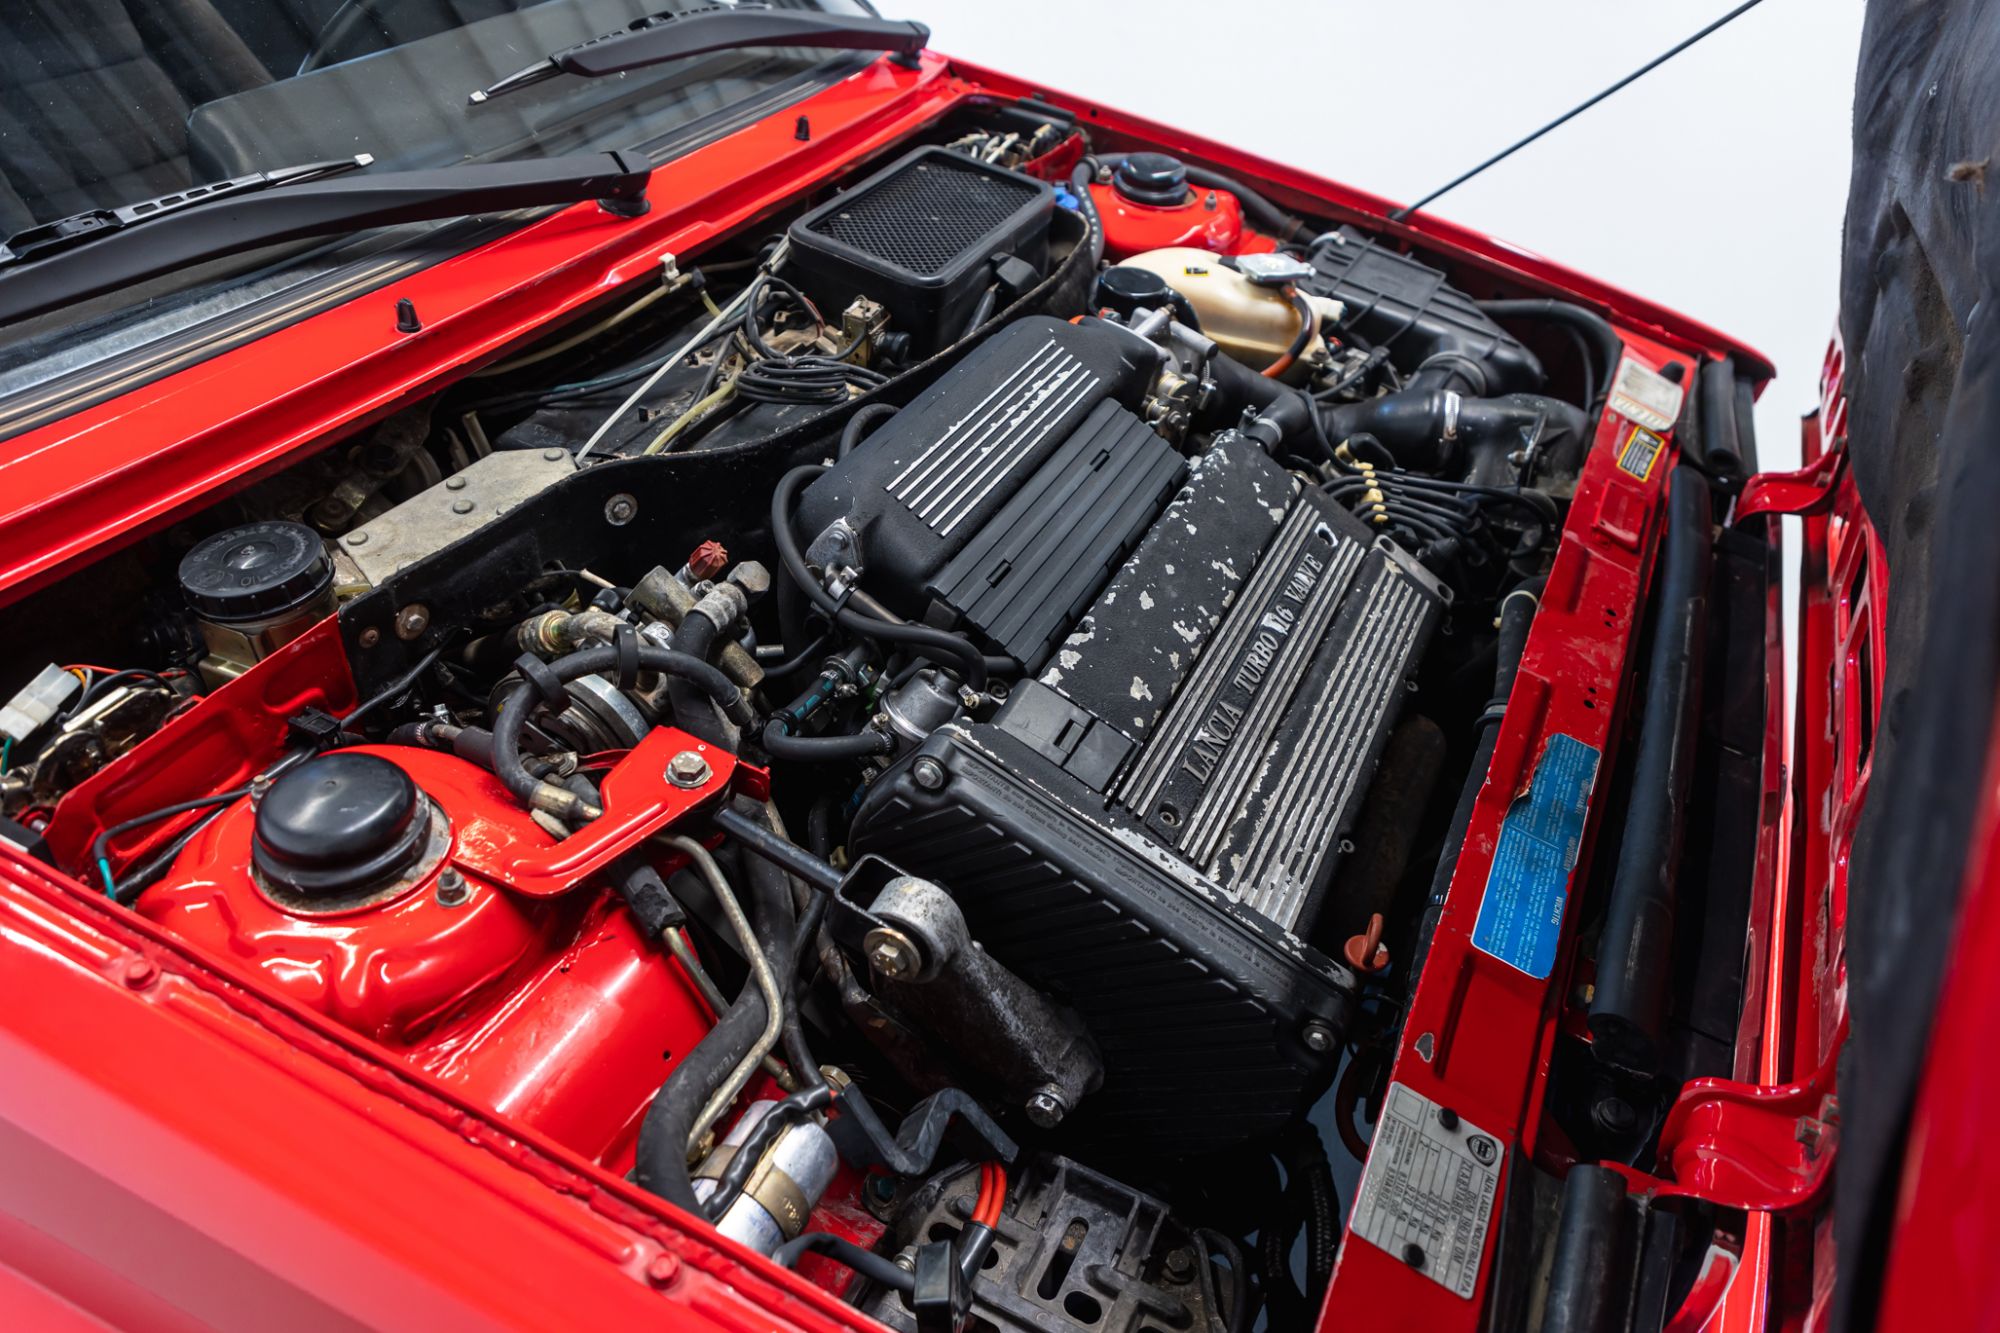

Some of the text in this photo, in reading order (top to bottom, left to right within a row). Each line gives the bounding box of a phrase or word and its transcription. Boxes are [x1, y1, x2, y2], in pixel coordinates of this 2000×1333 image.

[1182, 553, 1324, 785] LANCIA TURBO 16 VALVE
[1552, 896, 1564, 926] WICHTIG
